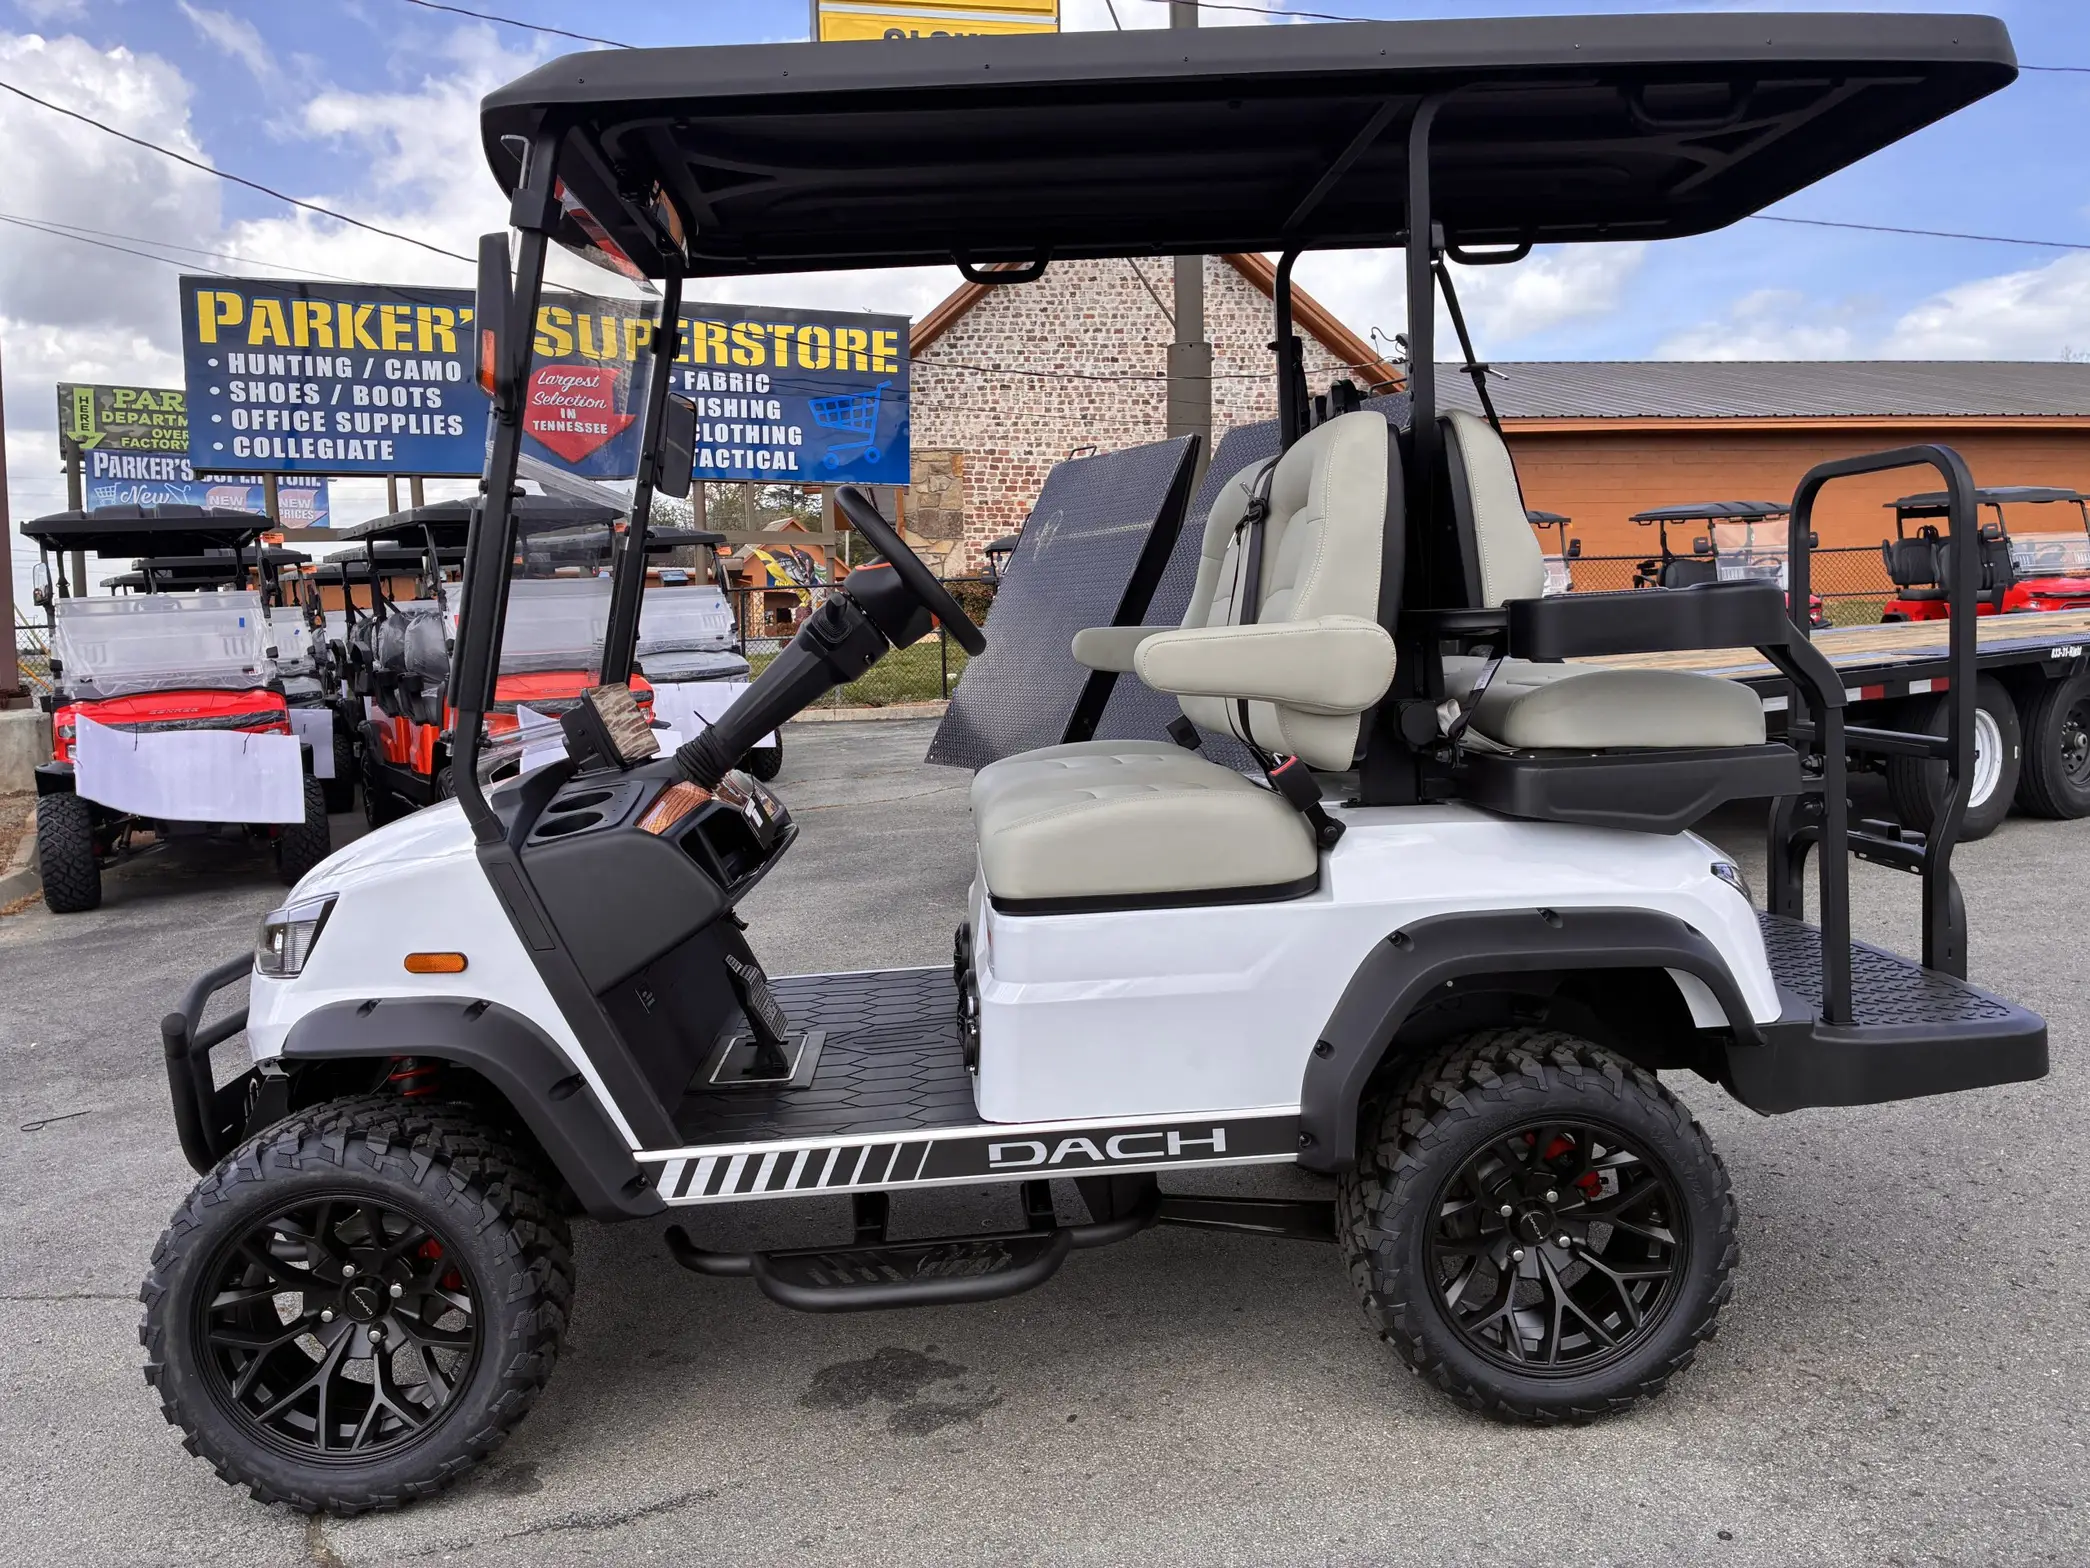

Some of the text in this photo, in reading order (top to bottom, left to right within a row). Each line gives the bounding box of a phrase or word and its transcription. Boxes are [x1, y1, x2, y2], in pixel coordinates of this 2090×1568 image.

[228, 352, 462, 382] HUNTING / CAMO
[537, 371, 601, 392] Largest
[684, 370, 770, 394] FABRIC
[112, 388, 188, 412] PAR
[229, 380, 442, 408] SHOES / BOOTS
[532, 391, 607, 409] Selection
[79, 395, 91, 432] HERE
[231, 408, 463, 436] OFFICE SUPPLIES
[560, 407, 577, 420] IN
[532, 420, 608, 435] TENNESSEE
[233, 436, 394, 460] COLLEGIATE
[93, 451, 194, 481] PARKER'S
[120, 484, 170, 504] New
[208, 494, 243, 507] NEW
[279, 497, 313, 509] NEW
[988, 1127, 1227, 1169] DACH
